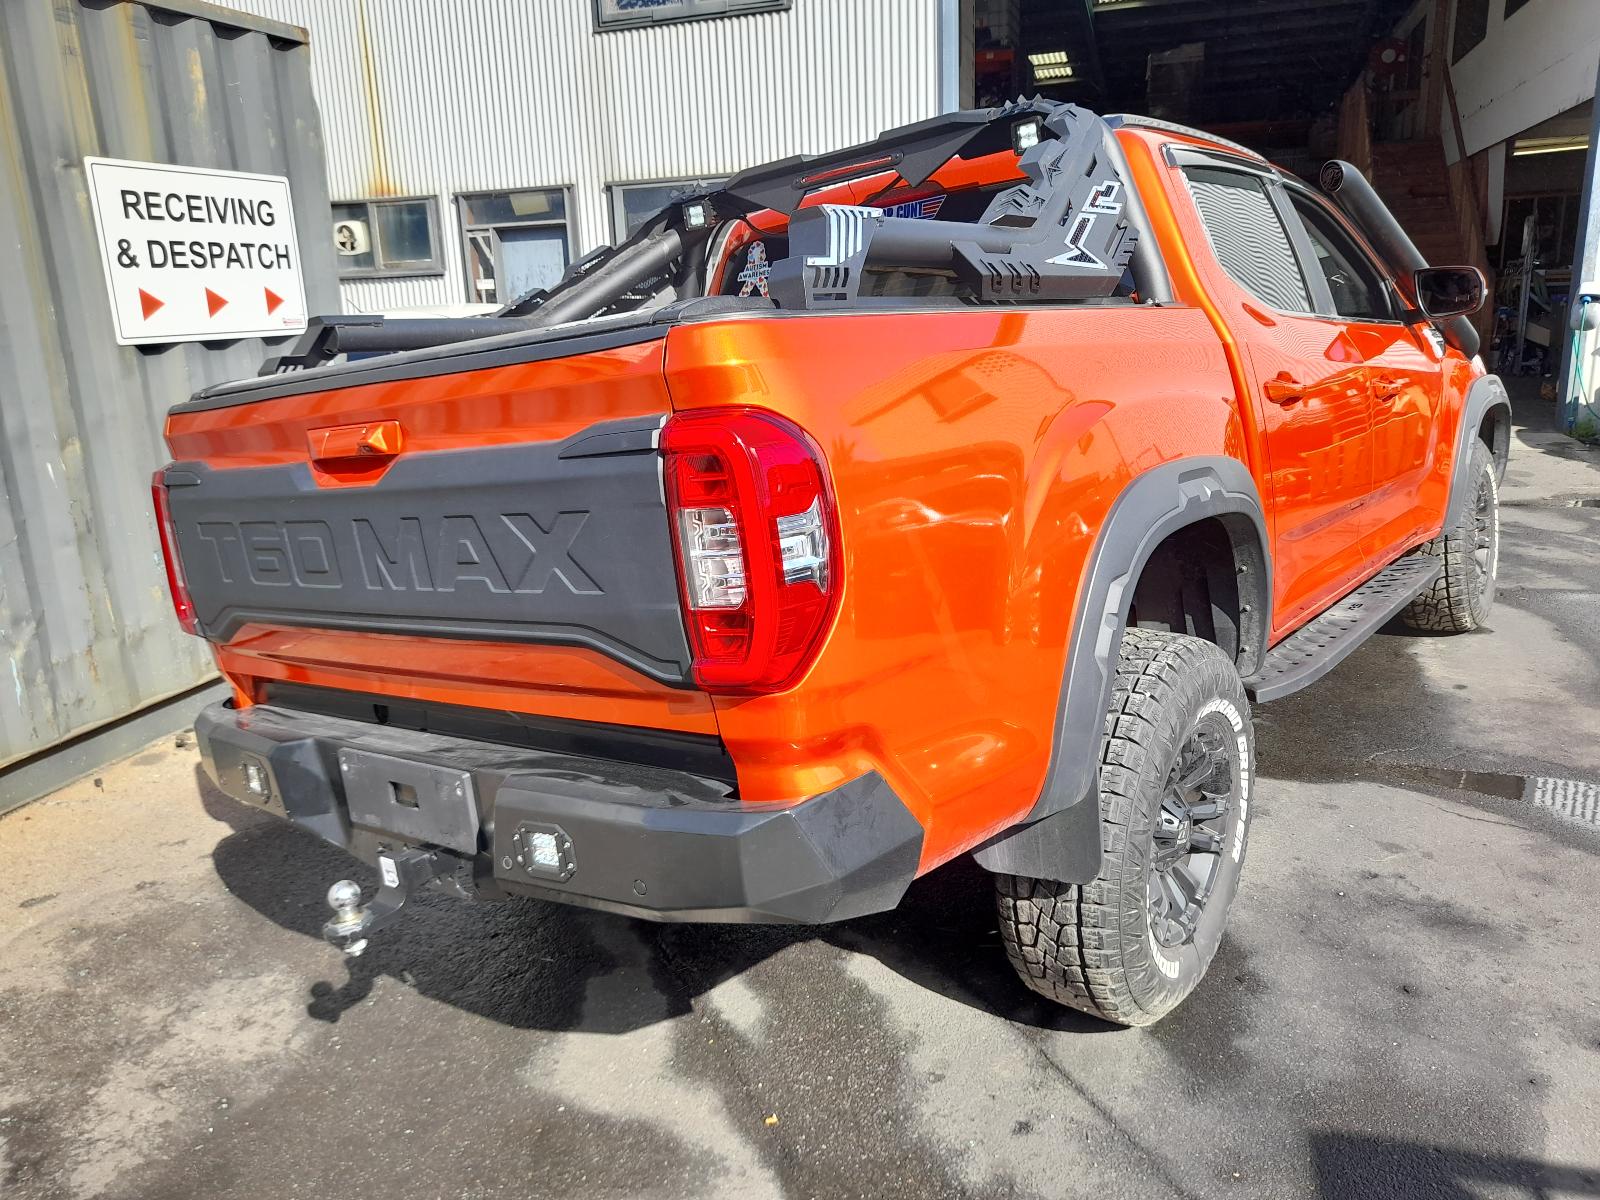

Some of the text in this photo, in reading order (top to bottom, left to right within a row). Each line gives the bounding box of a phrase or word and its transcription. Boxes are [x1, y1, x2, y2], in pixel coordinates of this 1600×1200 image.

[120, 189, 276, 226] RECEIVING
[117, 239, 292, 269] & DESPATCH
[745, 263, 767, 272] AUTISM
[738, 269, 770, 280] AWARENES
[197, 510, 606, 594] T60 MAX
[1232, 735, 1249, 863] GRIPPER
